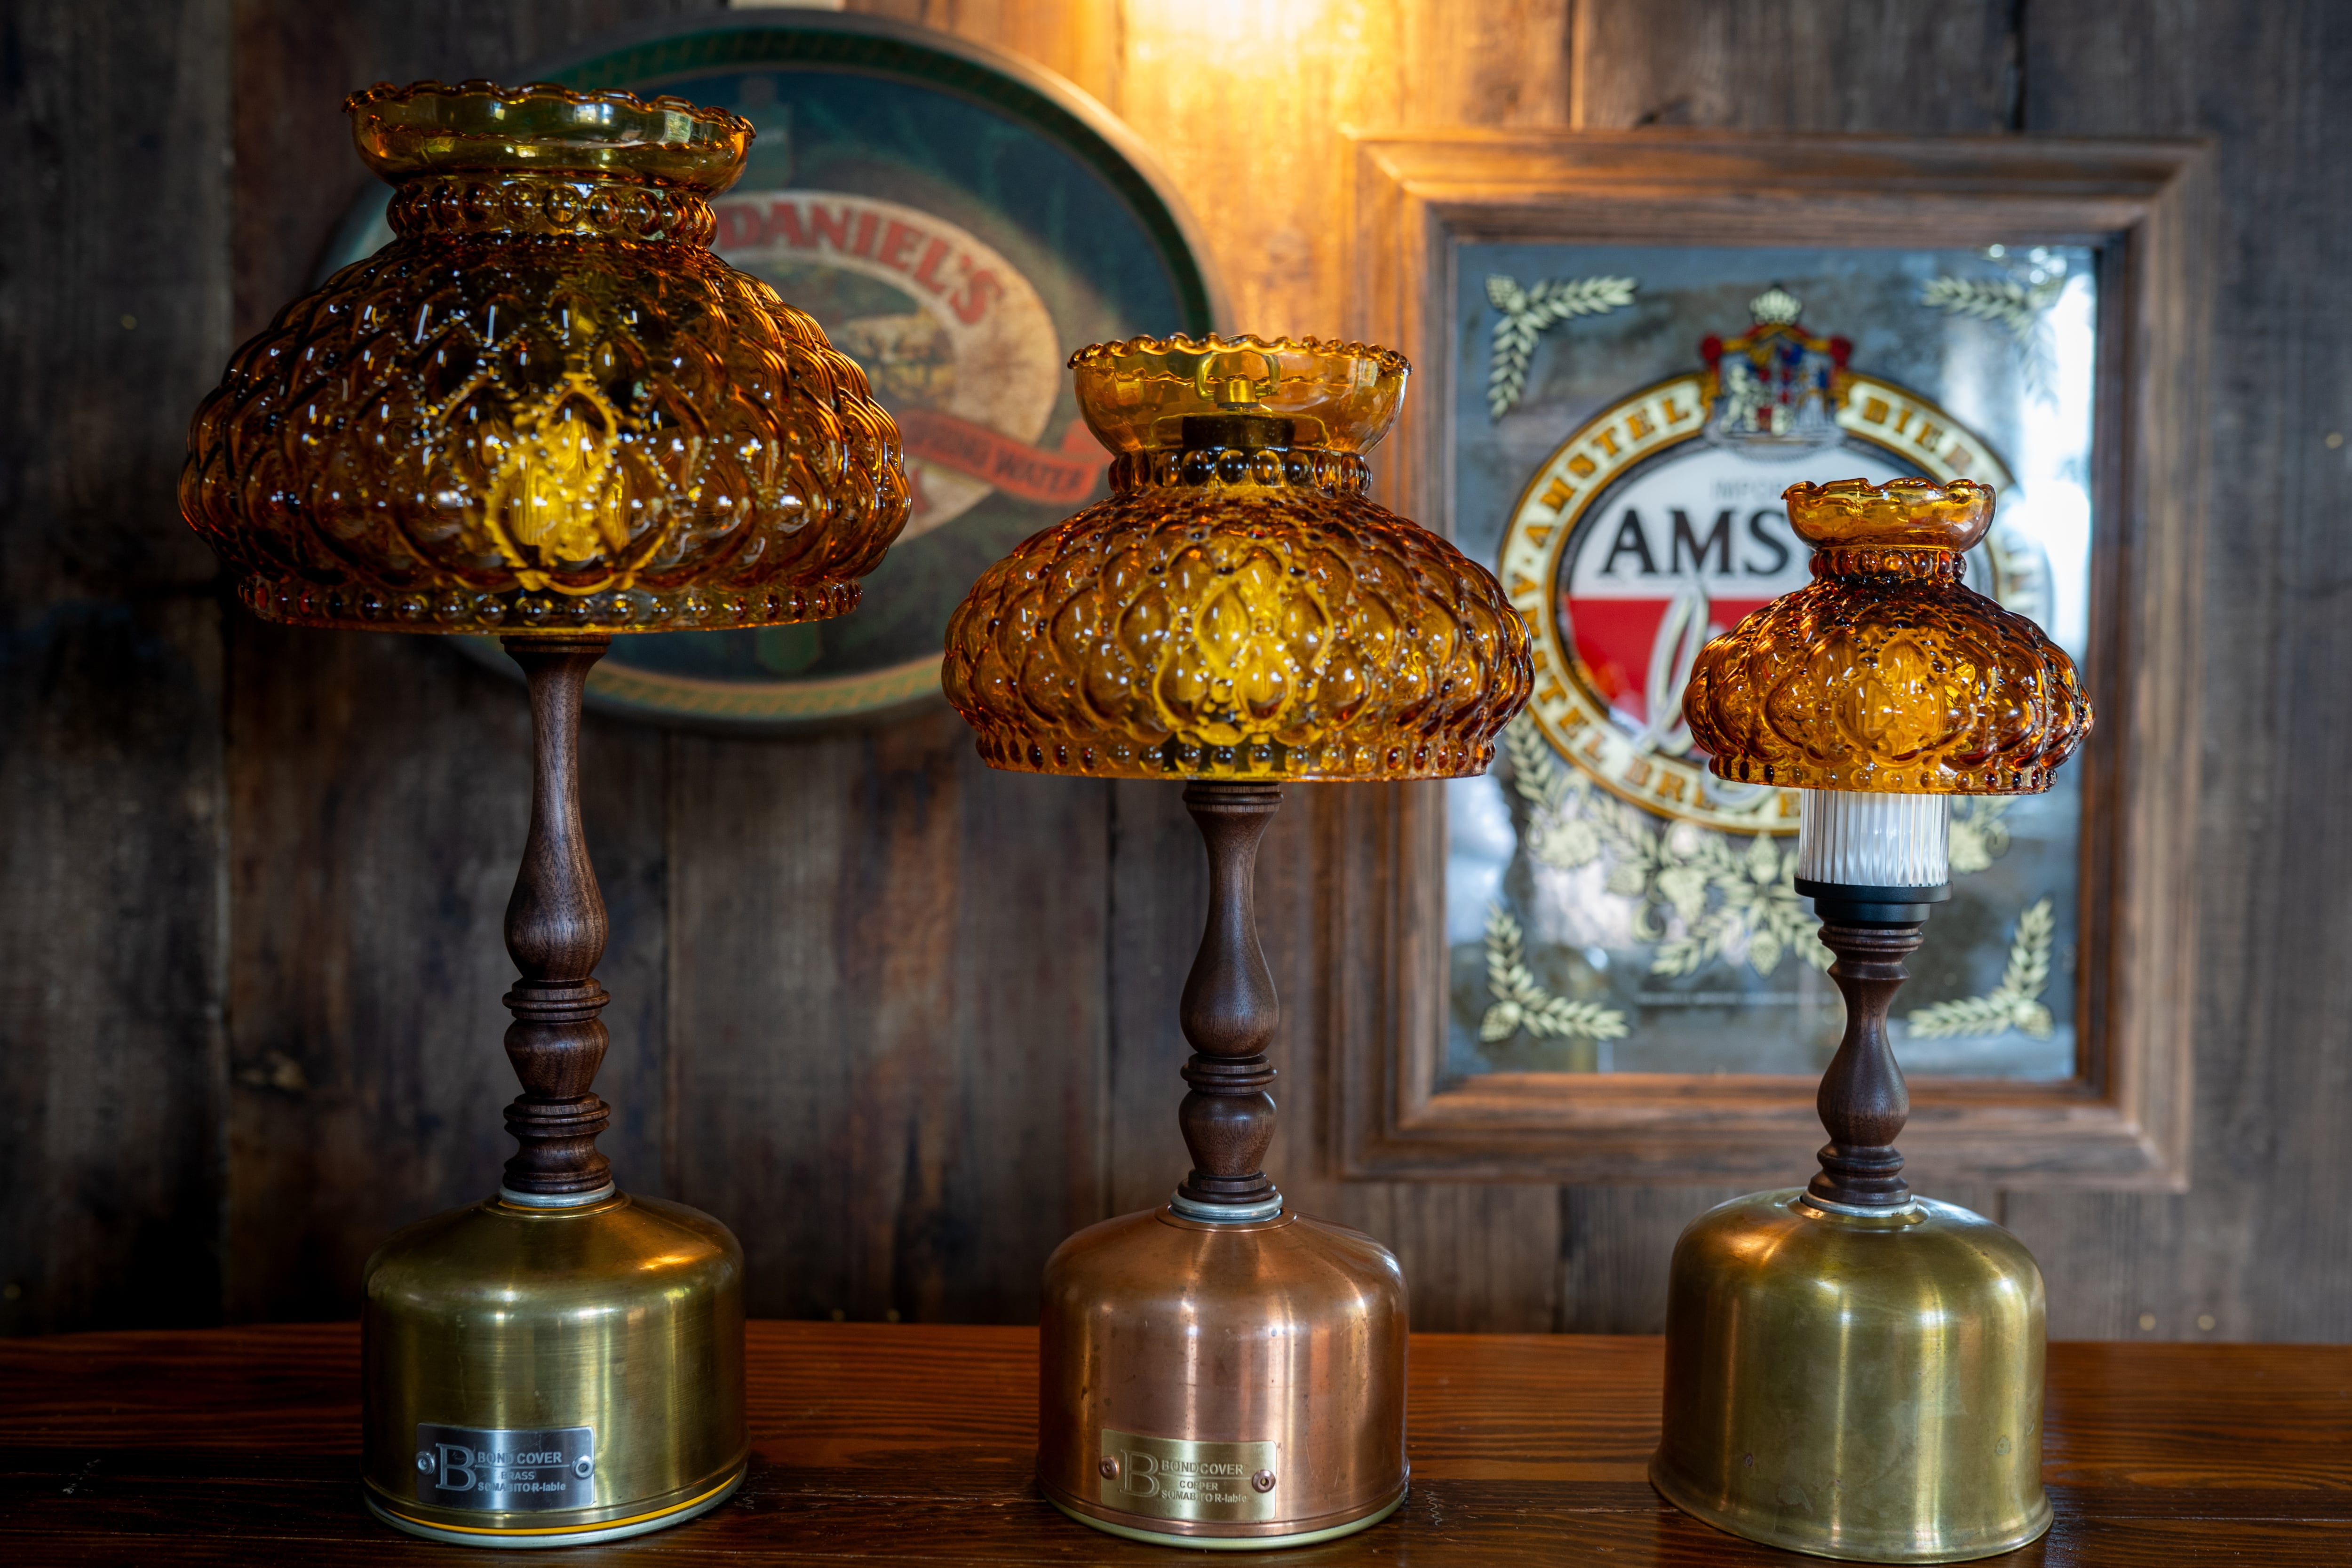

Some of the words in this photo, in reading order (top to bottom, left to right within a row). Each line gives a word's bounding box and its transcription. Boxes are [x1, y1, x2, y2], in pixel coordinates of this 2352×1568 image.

[717, 201, 1005, 326] DANIEL'S
[1524, 398, 1690, 549] AMSTEL
[1864, 397, 1972, 474] BIER
[1595, 507, 1789, 577] AMS
[477, 1451, 515, 1464] BOND
[517, 1452, 562, 1465] COVER
[1162, 1459, 1198, 1473] BOND
[1200, 1463, 1244, 1475] COVER
[501, 1471, 535, 1480] BRASS
[477, 1482, 530, 1492] SOMABITO
[1180, 1480, 1218, 1491] COPPER
[1161, 1490, 1213, 1502] SOMABITO
